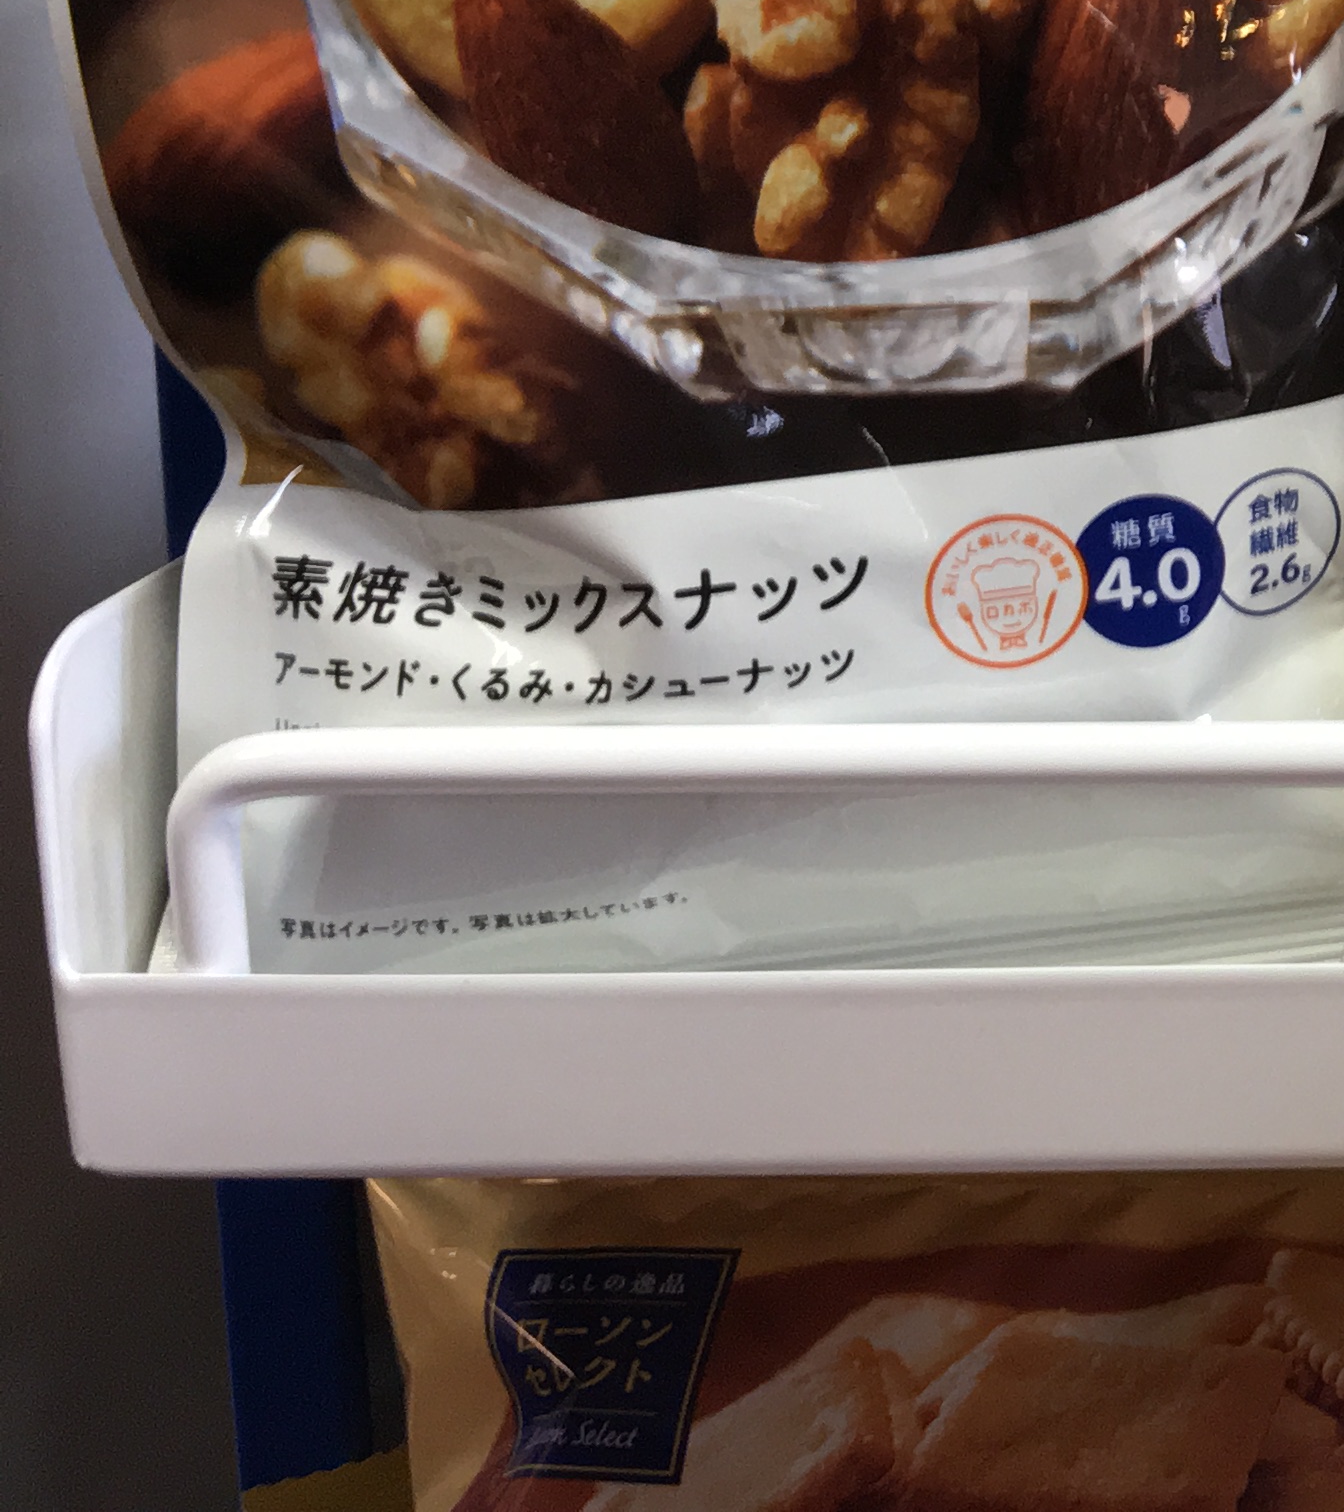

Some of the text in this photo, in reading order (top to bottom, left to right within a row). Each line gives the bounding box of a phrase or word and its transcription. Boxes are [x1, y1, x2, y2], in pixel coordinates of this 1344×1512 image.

[1248, 488, 1299, 524] 食物
[1110, 511, 1177, 551] 糖質
[1249, 519, 1298, 557] 繊維
[272, 551, 870, 633] 素焼きミックスナッツ
[1094, 546, 1202, 611] 4.0
[274, 646, 855, 706] アーモンド・くるみ・カシューナッツ
[515, 1315, 674, 1354] ローソン
